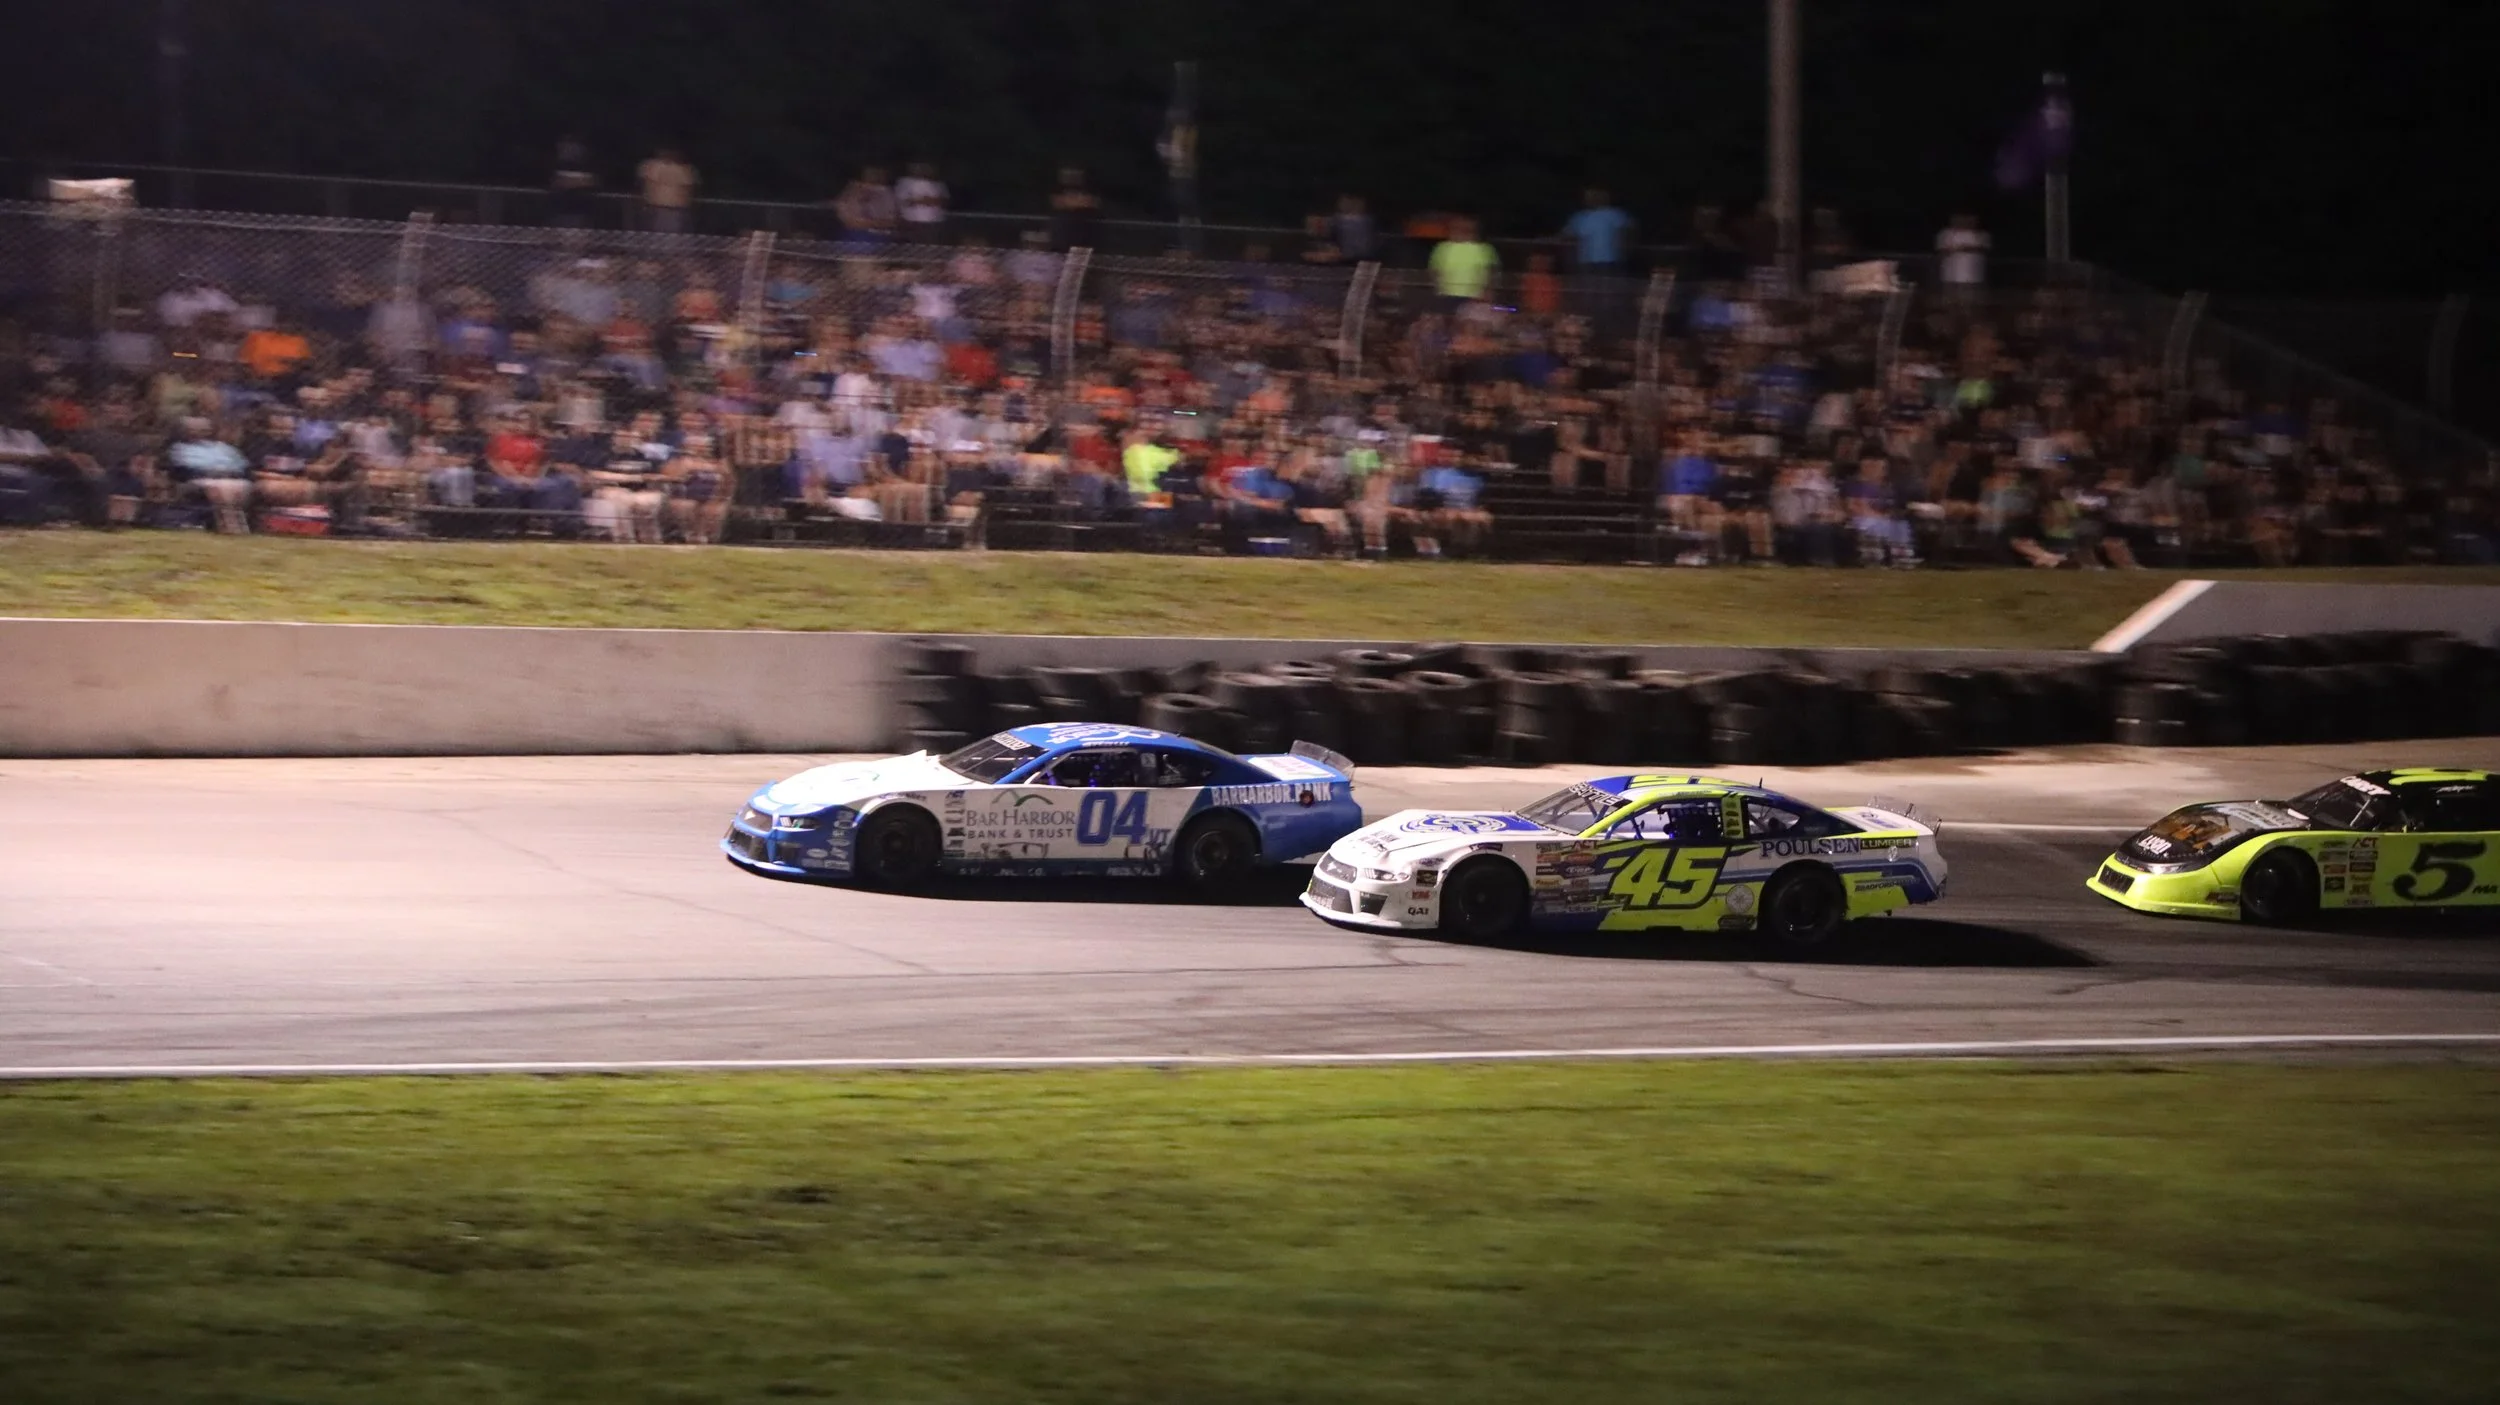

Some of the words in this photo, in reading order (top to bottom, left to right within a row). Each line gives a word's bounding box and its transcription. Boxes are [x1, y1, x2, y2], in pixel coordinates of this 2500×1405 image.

[967, 829, 1006, 839] BANK
[1014, 830, 1022, 838] &
[1029, 828, 1073, 838] TRUST
[1077, 790, 1150, 845] 04
[1760, 837, 1861, 858] POULSEN
[1861, 838, 1912, 849] LUMBER
[2393, 840, 2487, 901] 5
[1609, 845, 1726, 911] 45
